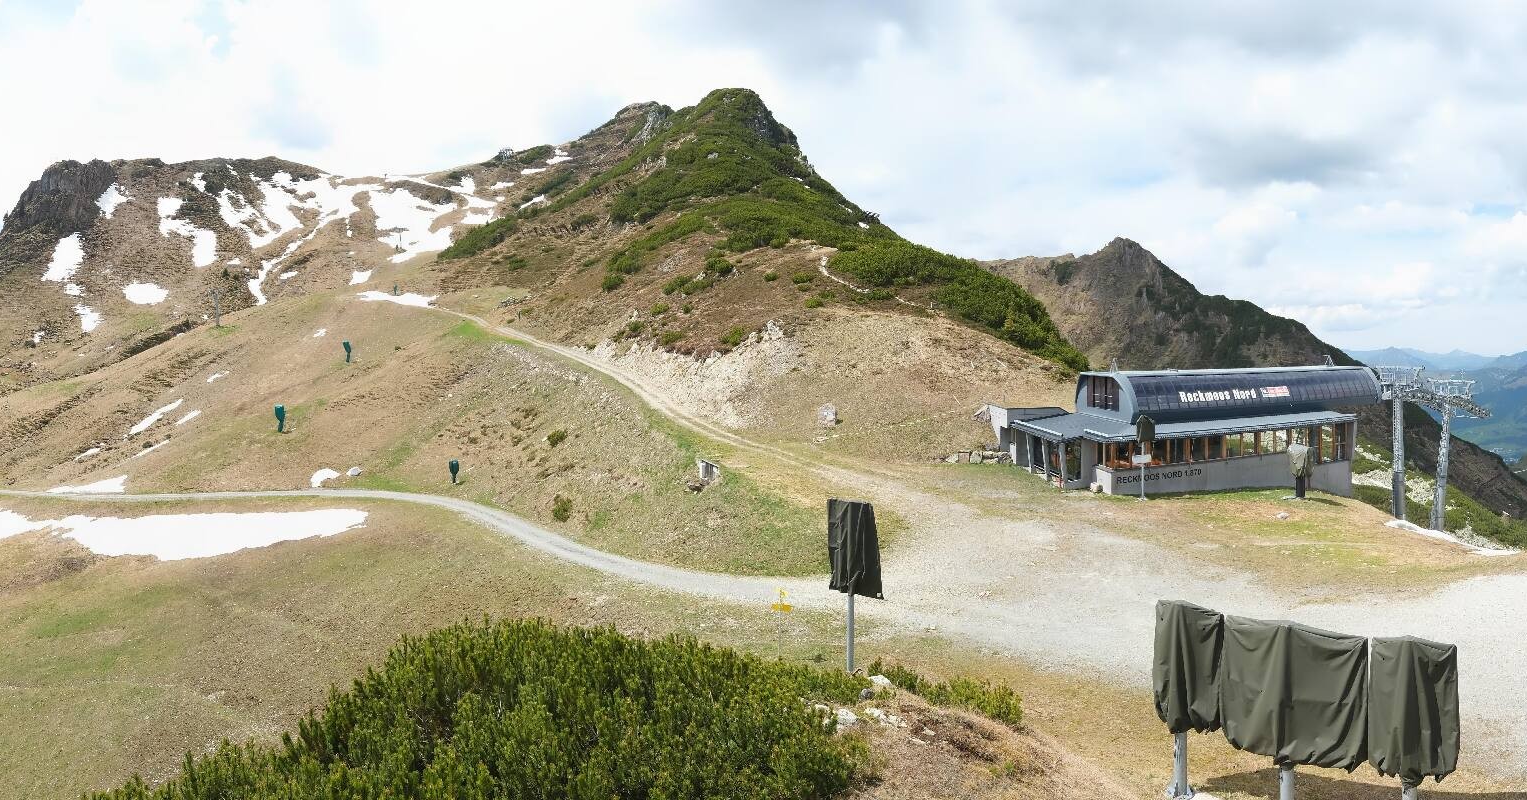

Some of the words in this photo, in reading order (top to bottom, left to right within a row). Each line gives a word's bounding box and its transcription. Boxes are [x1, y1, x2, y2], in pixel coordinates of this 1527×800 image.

[1178, 390, 1231, 402] Reckmoos
[1232, 388, 1257, 400] Nord
[1162, 470, 1183, 480] NORD
